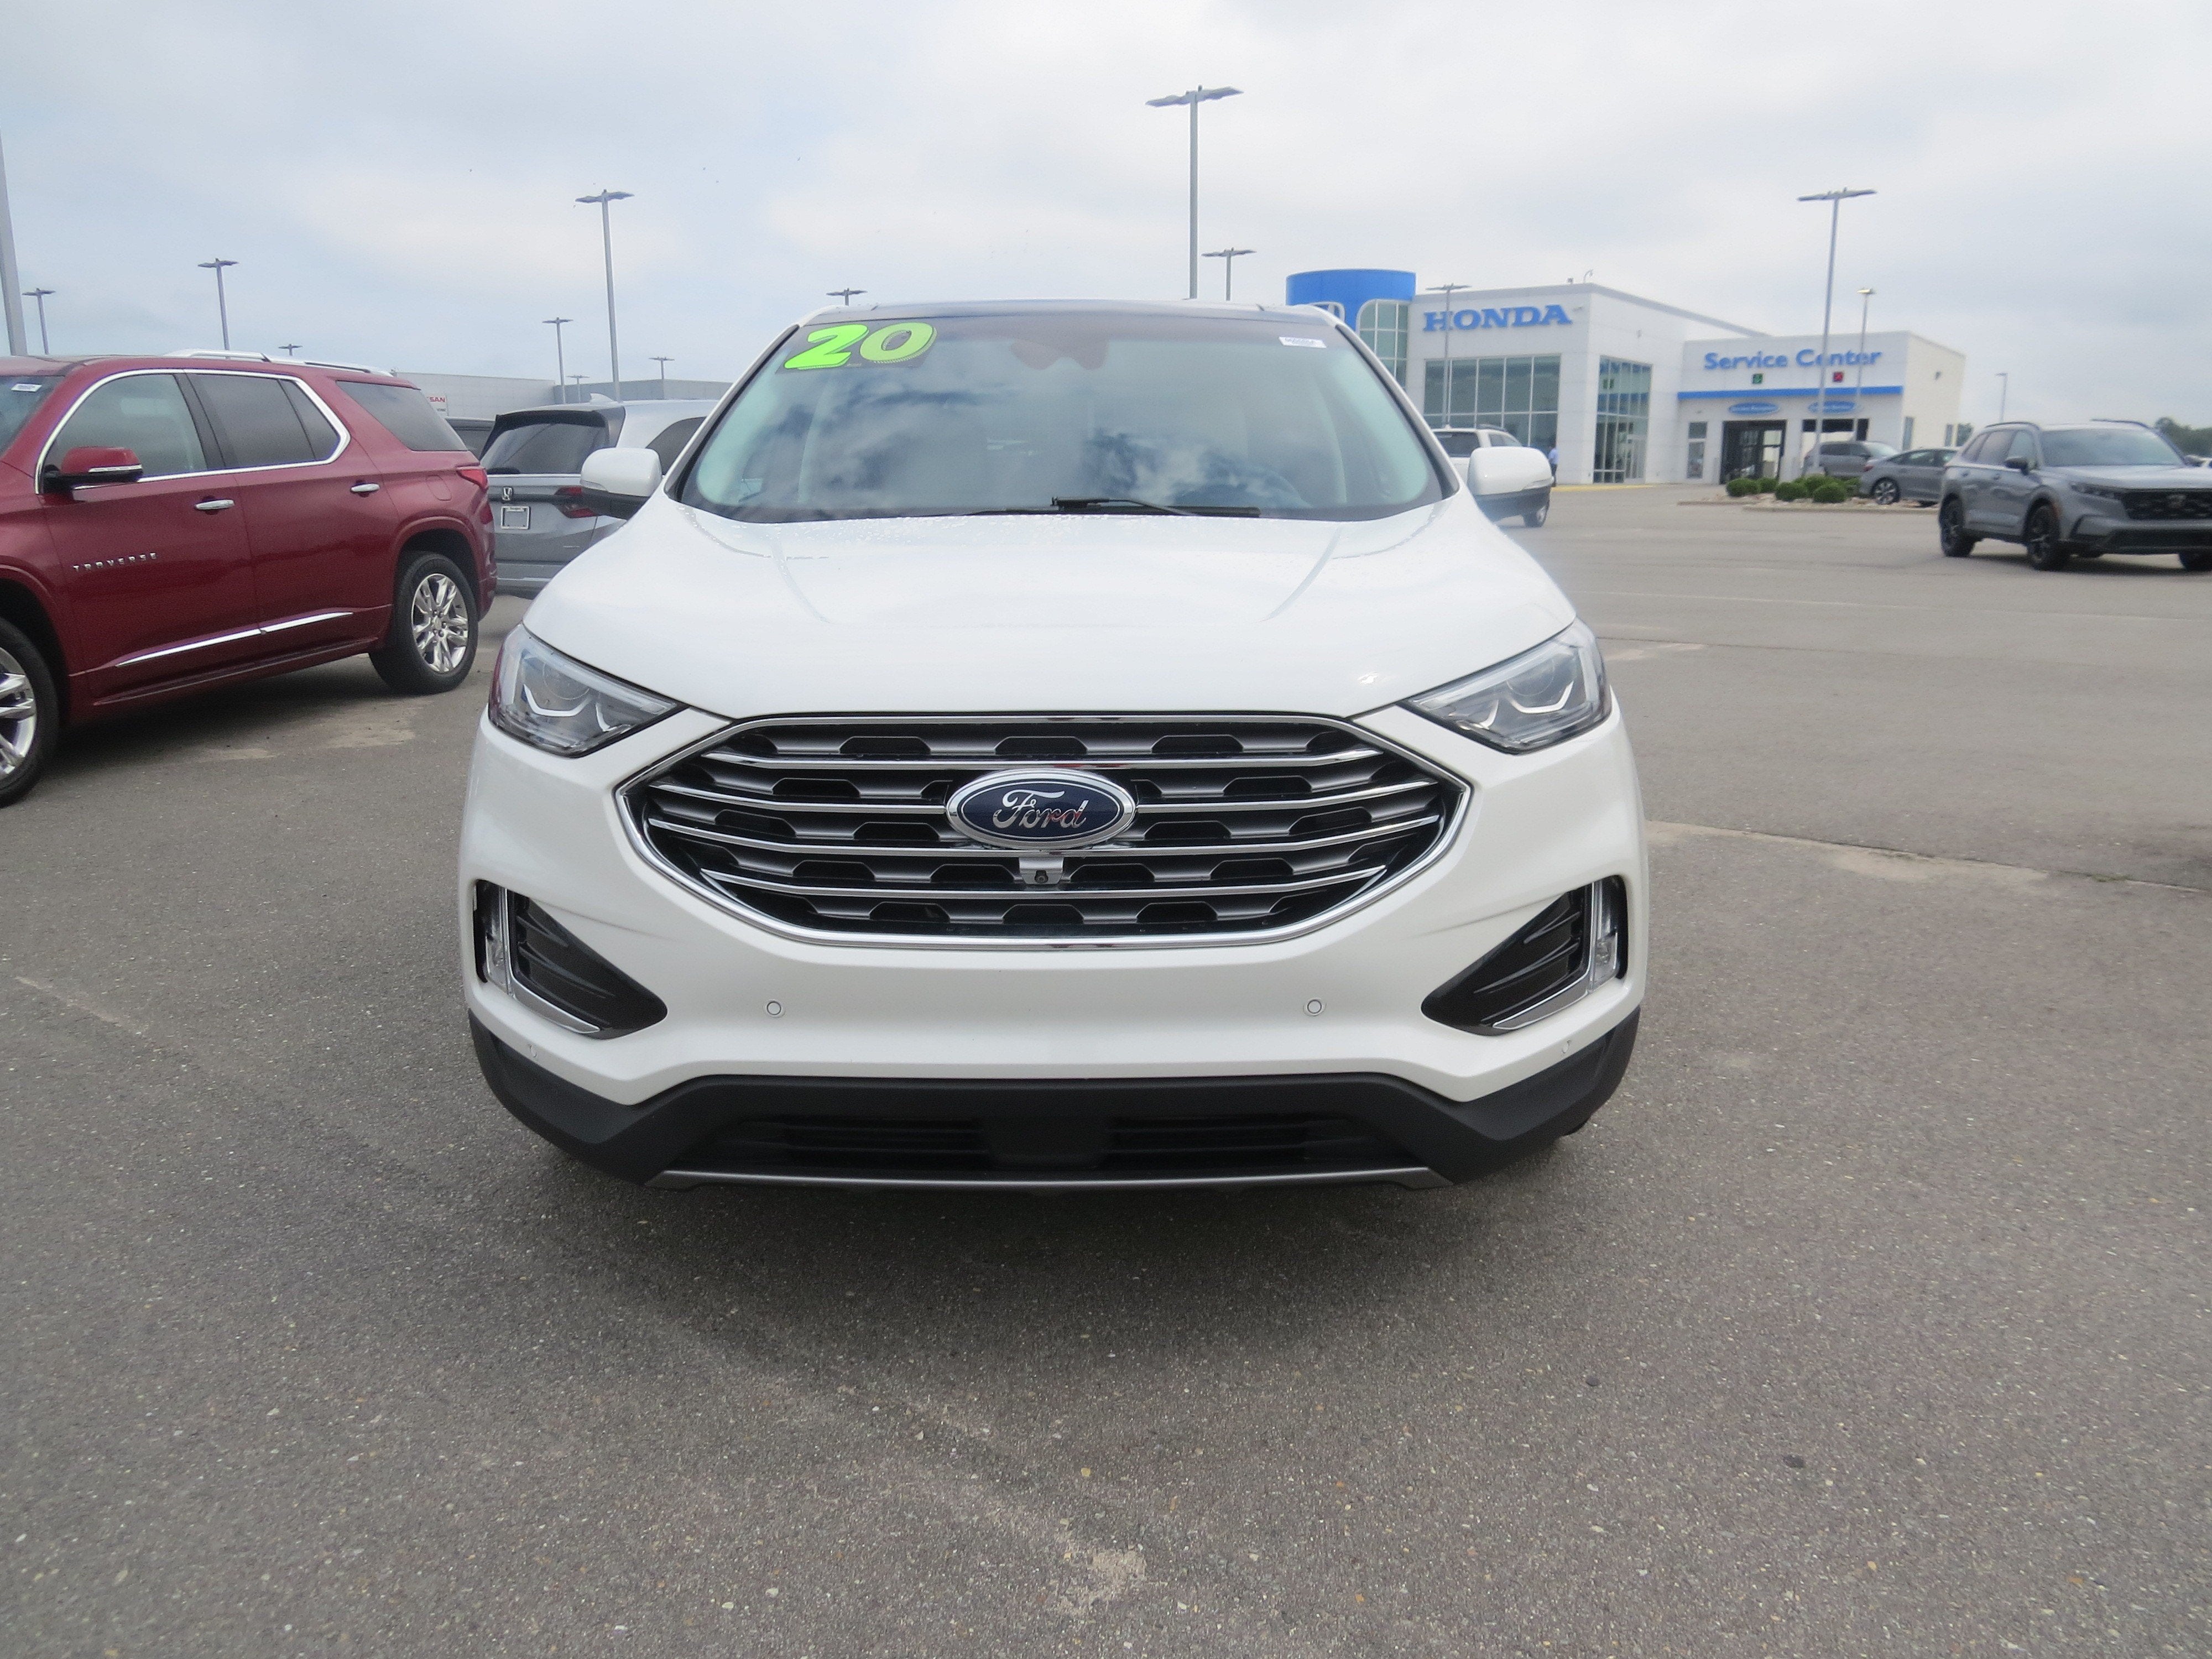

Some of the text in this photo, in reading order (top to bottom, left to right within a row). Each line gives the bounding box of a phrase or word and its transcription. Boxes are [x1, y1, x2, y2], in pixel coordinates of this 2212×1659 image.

[1423, 304, 1573, 332] HONDA
[783, 322, 937, 370] 20
[1704, 348, 1882, 370] Service Center
[72, 552, 156, 572] TRAVERSE
[993, 789, 1089, 829] Ford
